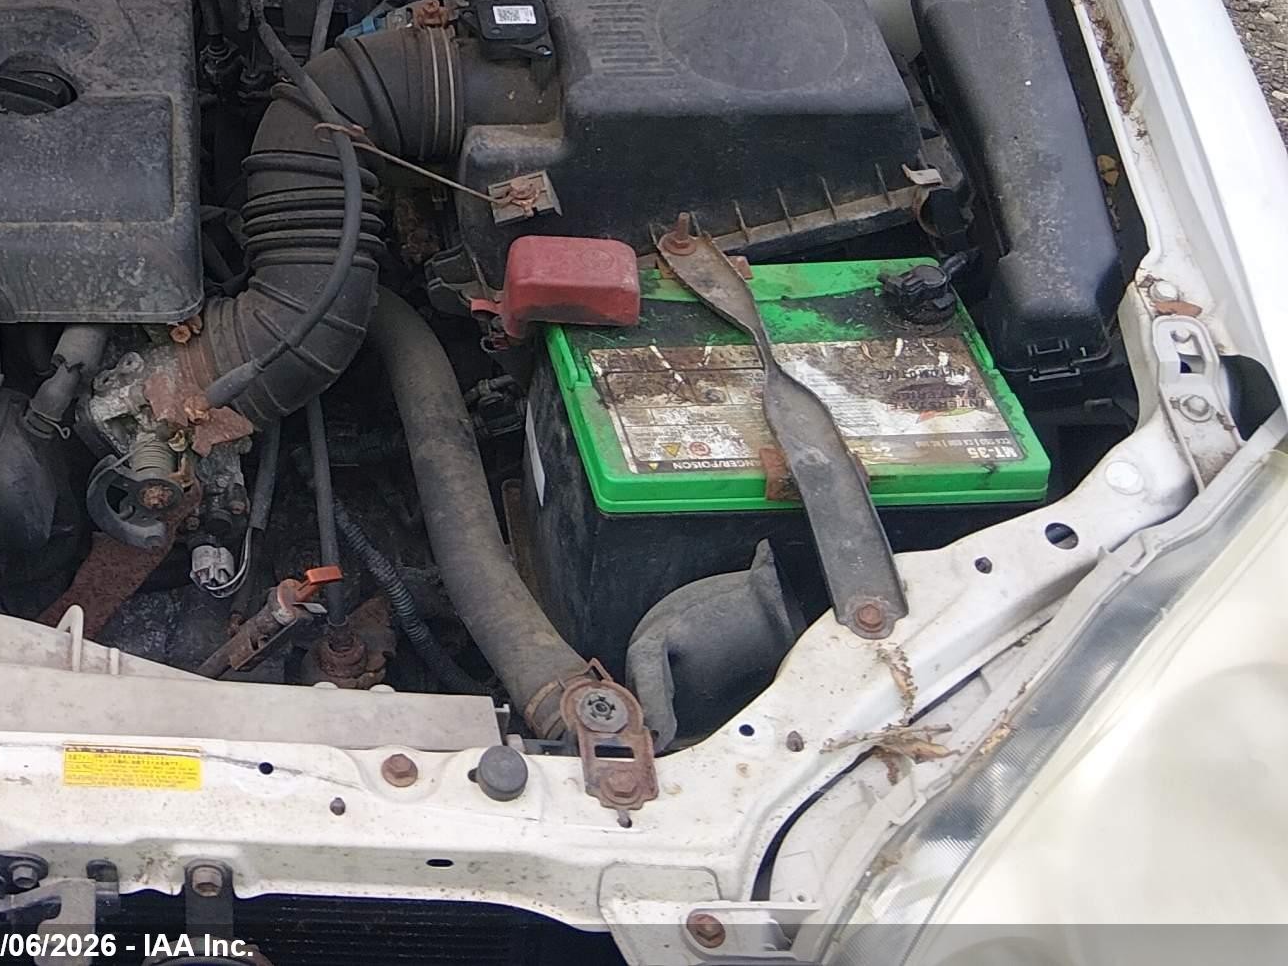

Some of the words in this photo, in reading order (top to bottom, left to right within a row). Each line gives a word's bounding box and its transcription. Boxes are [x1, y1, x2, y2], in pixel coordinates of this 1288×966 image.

[886, 398, 989, 411] INTERSTATE
[966, 445, 1018, 460] MT-35
[672, 459, 764, 470] ANGER/POISON
